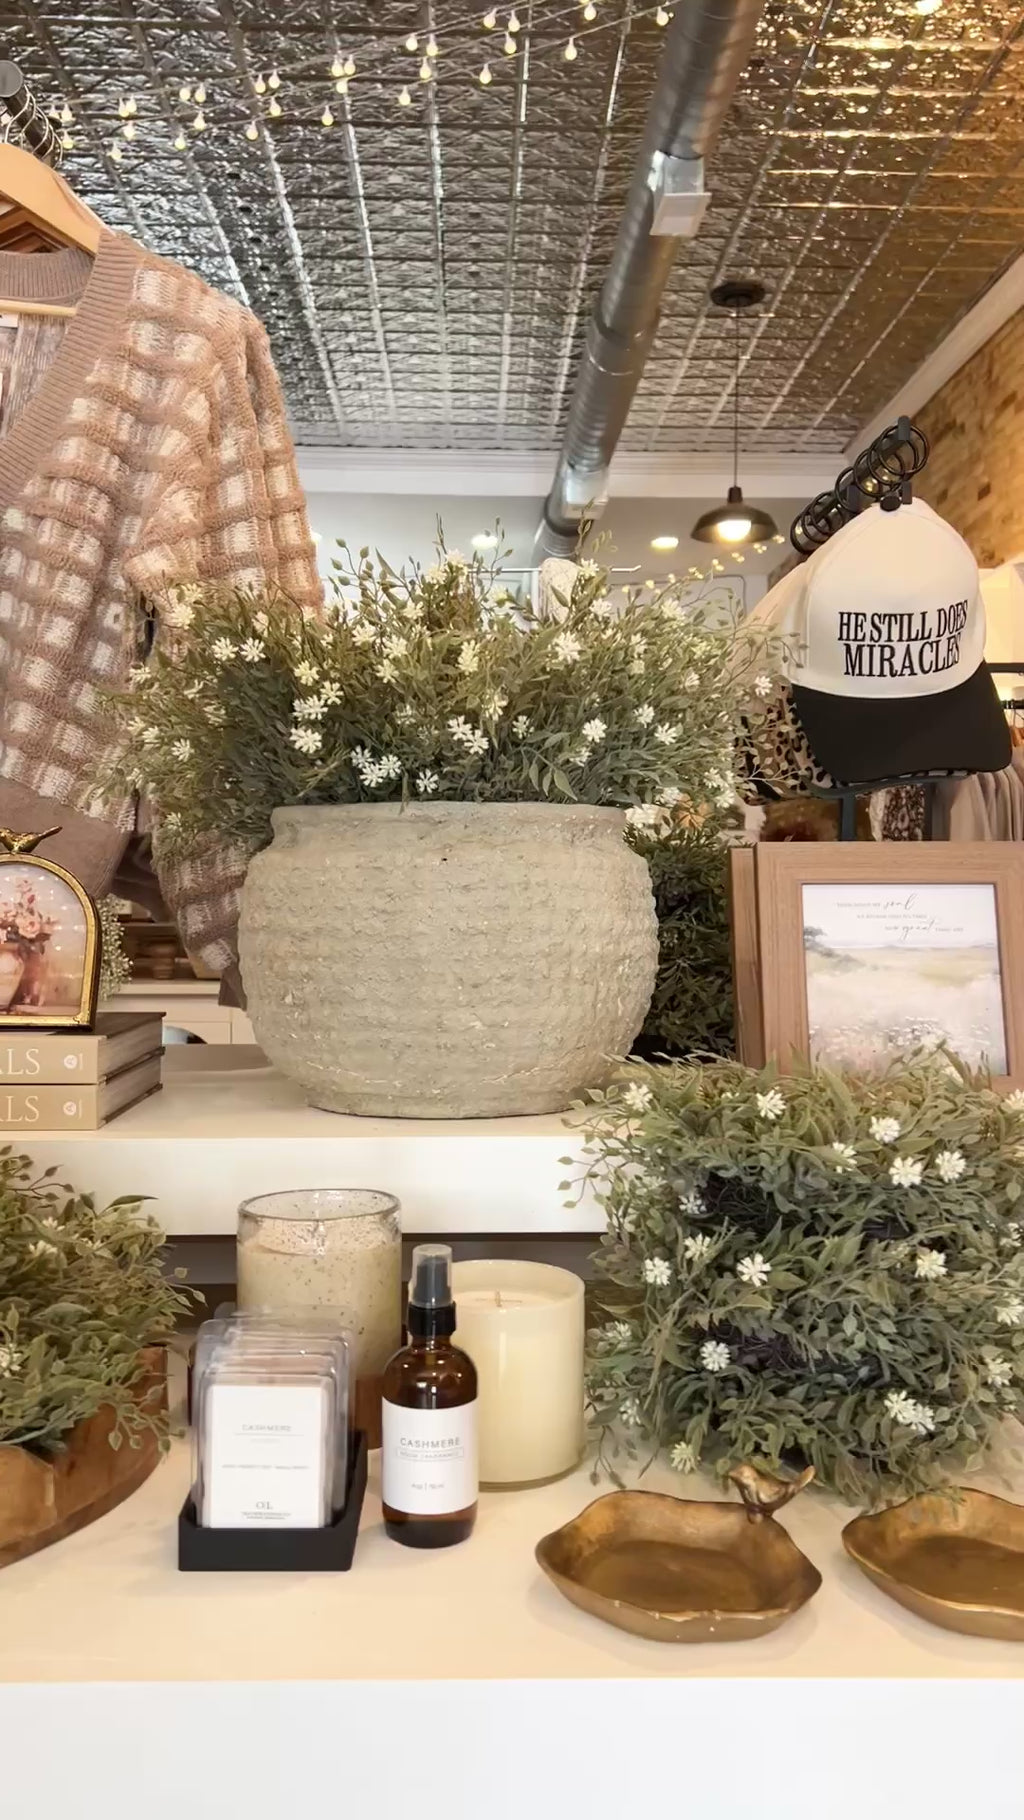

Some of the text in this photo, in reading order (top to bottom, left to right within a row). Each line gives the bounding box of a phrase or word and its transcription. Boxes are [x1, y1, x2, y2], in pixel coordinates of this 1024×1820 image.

[838, 599, 968, 643] HE STILL DOES
[843, 631, 961, 678] MIRACLES
[0, 1048, 40, 1075] LS
[0, 1095, 40, 1122] LS
[400, 1437, 461, 1449] CASHMERE
